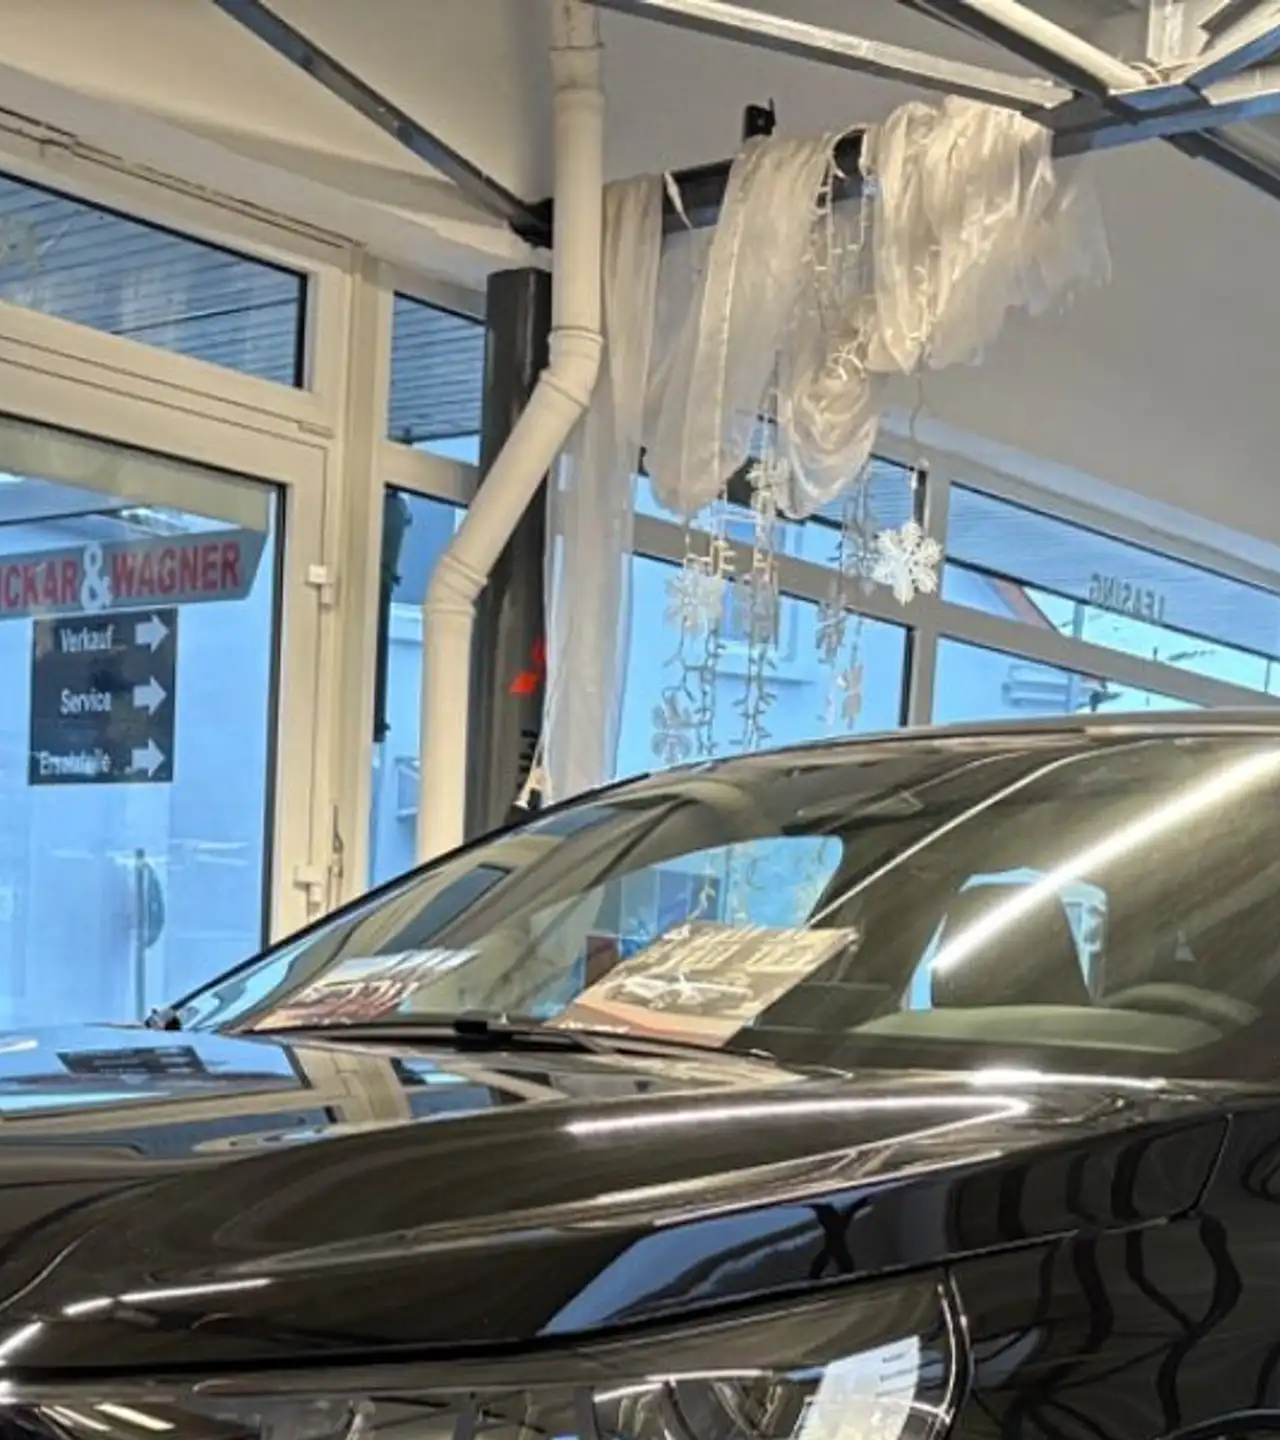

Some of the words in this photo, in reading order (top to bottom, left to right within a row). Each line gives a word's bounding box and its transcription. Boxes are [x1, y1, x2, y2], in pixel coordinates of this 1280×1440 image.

[80, 543, 113, 609] &
[113, 540, 241, 598] WAGNER
[60, 624, 114, 654] Verkauf
[60, 690, 112, 715] Service
